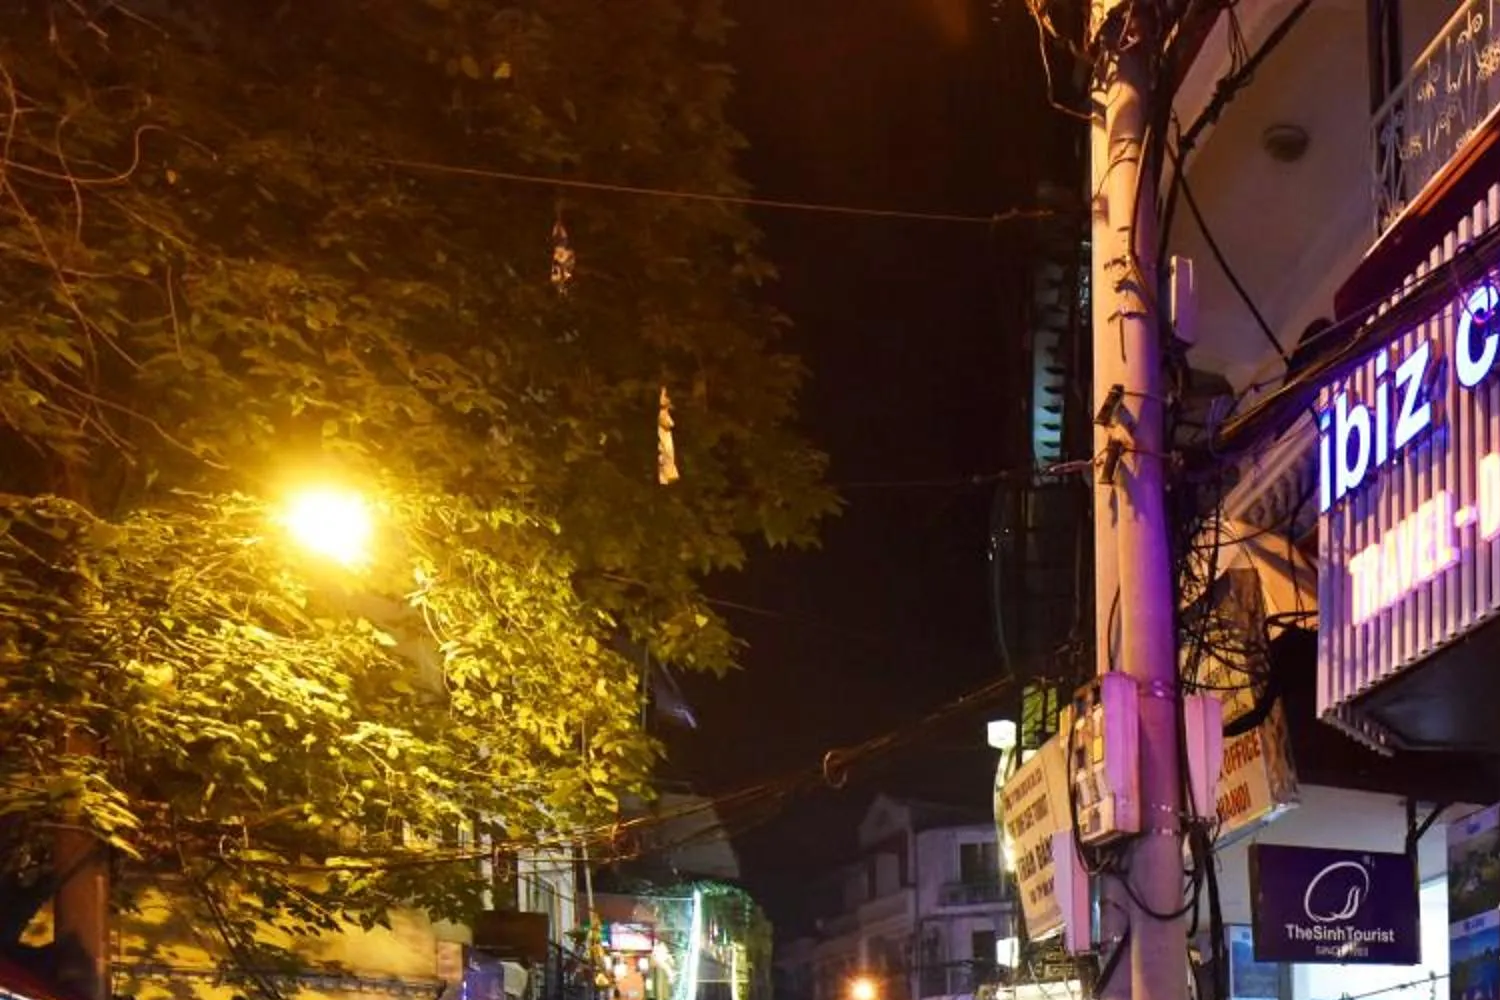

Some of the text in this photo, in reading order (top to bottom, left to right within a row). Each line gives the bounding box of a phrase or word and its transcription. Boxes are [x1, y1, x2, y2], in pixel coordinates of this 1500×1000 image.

[1318, 341, 1432, 514] ibiz
[1349, 489, 1458, 626] TRAVEL
[1223, 730, 1261, 776] OFFICE
[1284, 923, 1396, 944] TheSinhTourist
